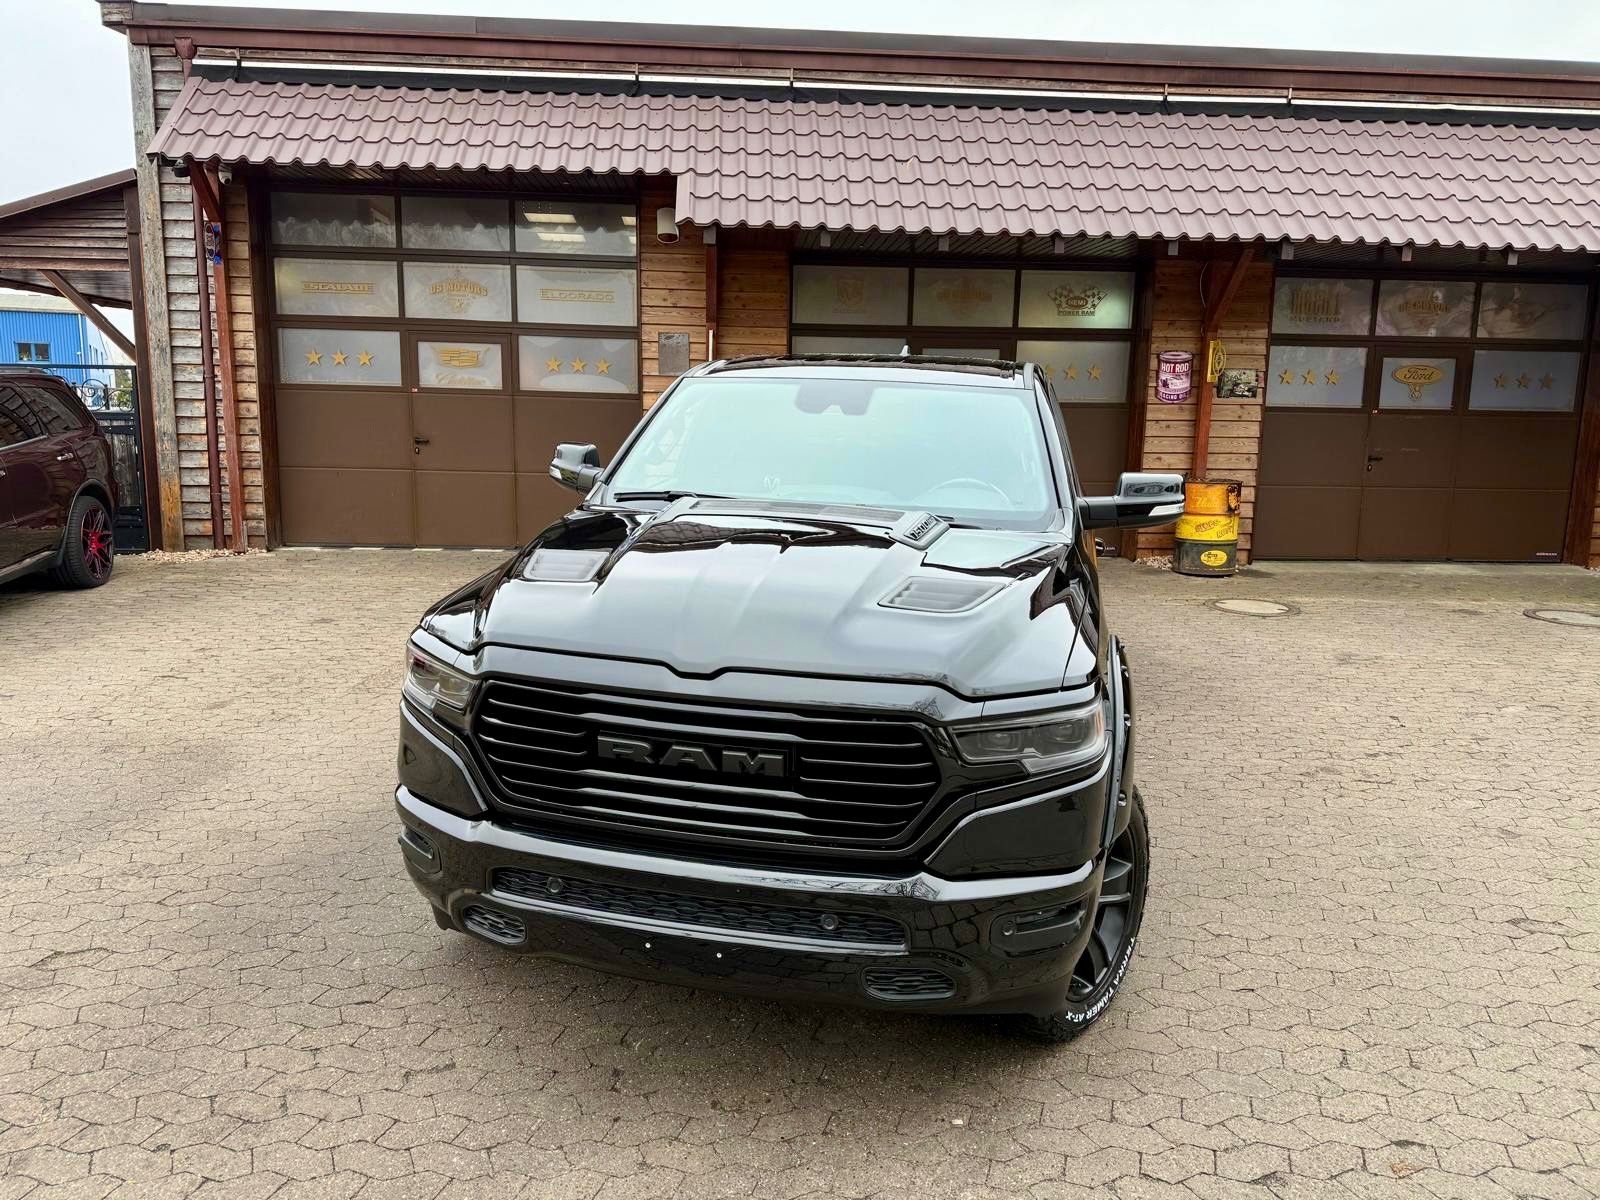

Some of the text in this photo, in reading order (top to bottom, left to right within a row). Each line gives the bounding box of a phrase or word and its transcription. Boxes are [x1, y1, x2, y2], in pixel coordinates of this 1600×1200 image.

[541, 289, 614, 301] ELDORADO
[1161, 362, 1189, 373] HOT ROD
[1404, 367, 1434, 380] Ford
[597, 736, 785, 777] RAM
[1086, 987, 1114, 1020] TAMER
